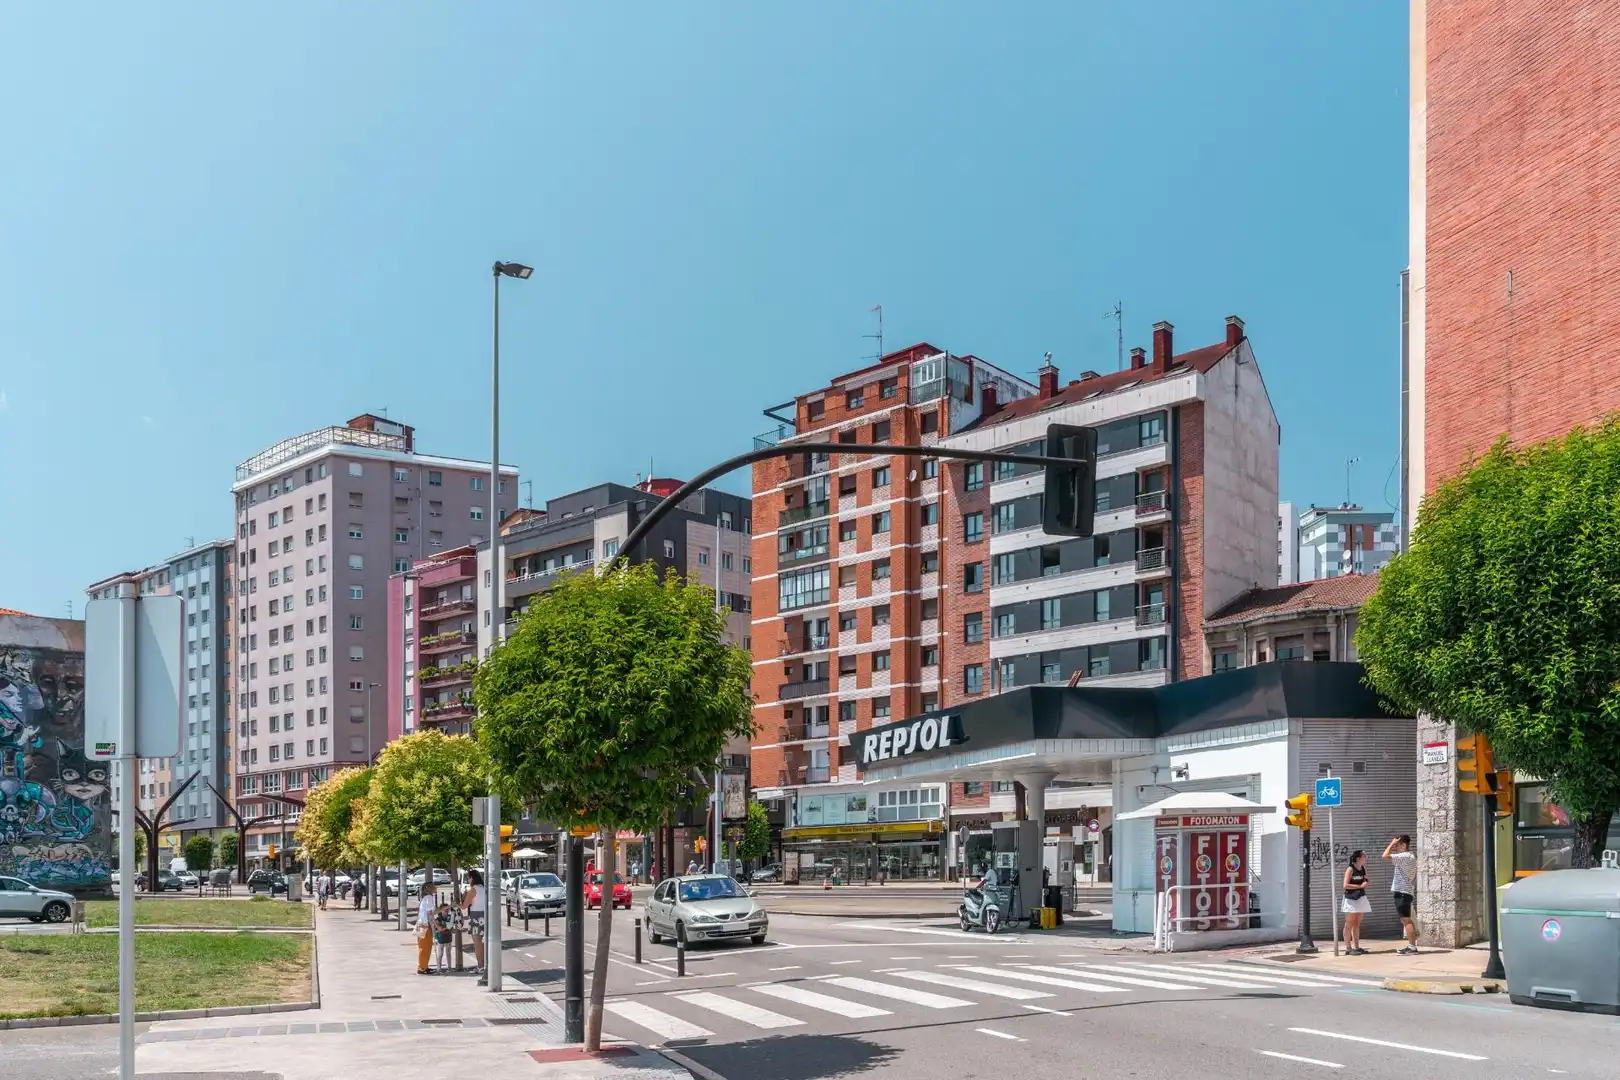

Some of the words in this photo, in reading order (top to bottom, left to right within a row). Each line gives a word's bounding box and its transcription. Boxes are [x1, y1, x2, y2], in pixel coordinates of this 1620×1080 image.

[863, 716, 951, 763] REPSOL
[1190, 816, 1240, 825] FOTOMATON
[1195, 835, 1212, 930] FOTOS
[1225, 834, 1241, 929] FOTOS
